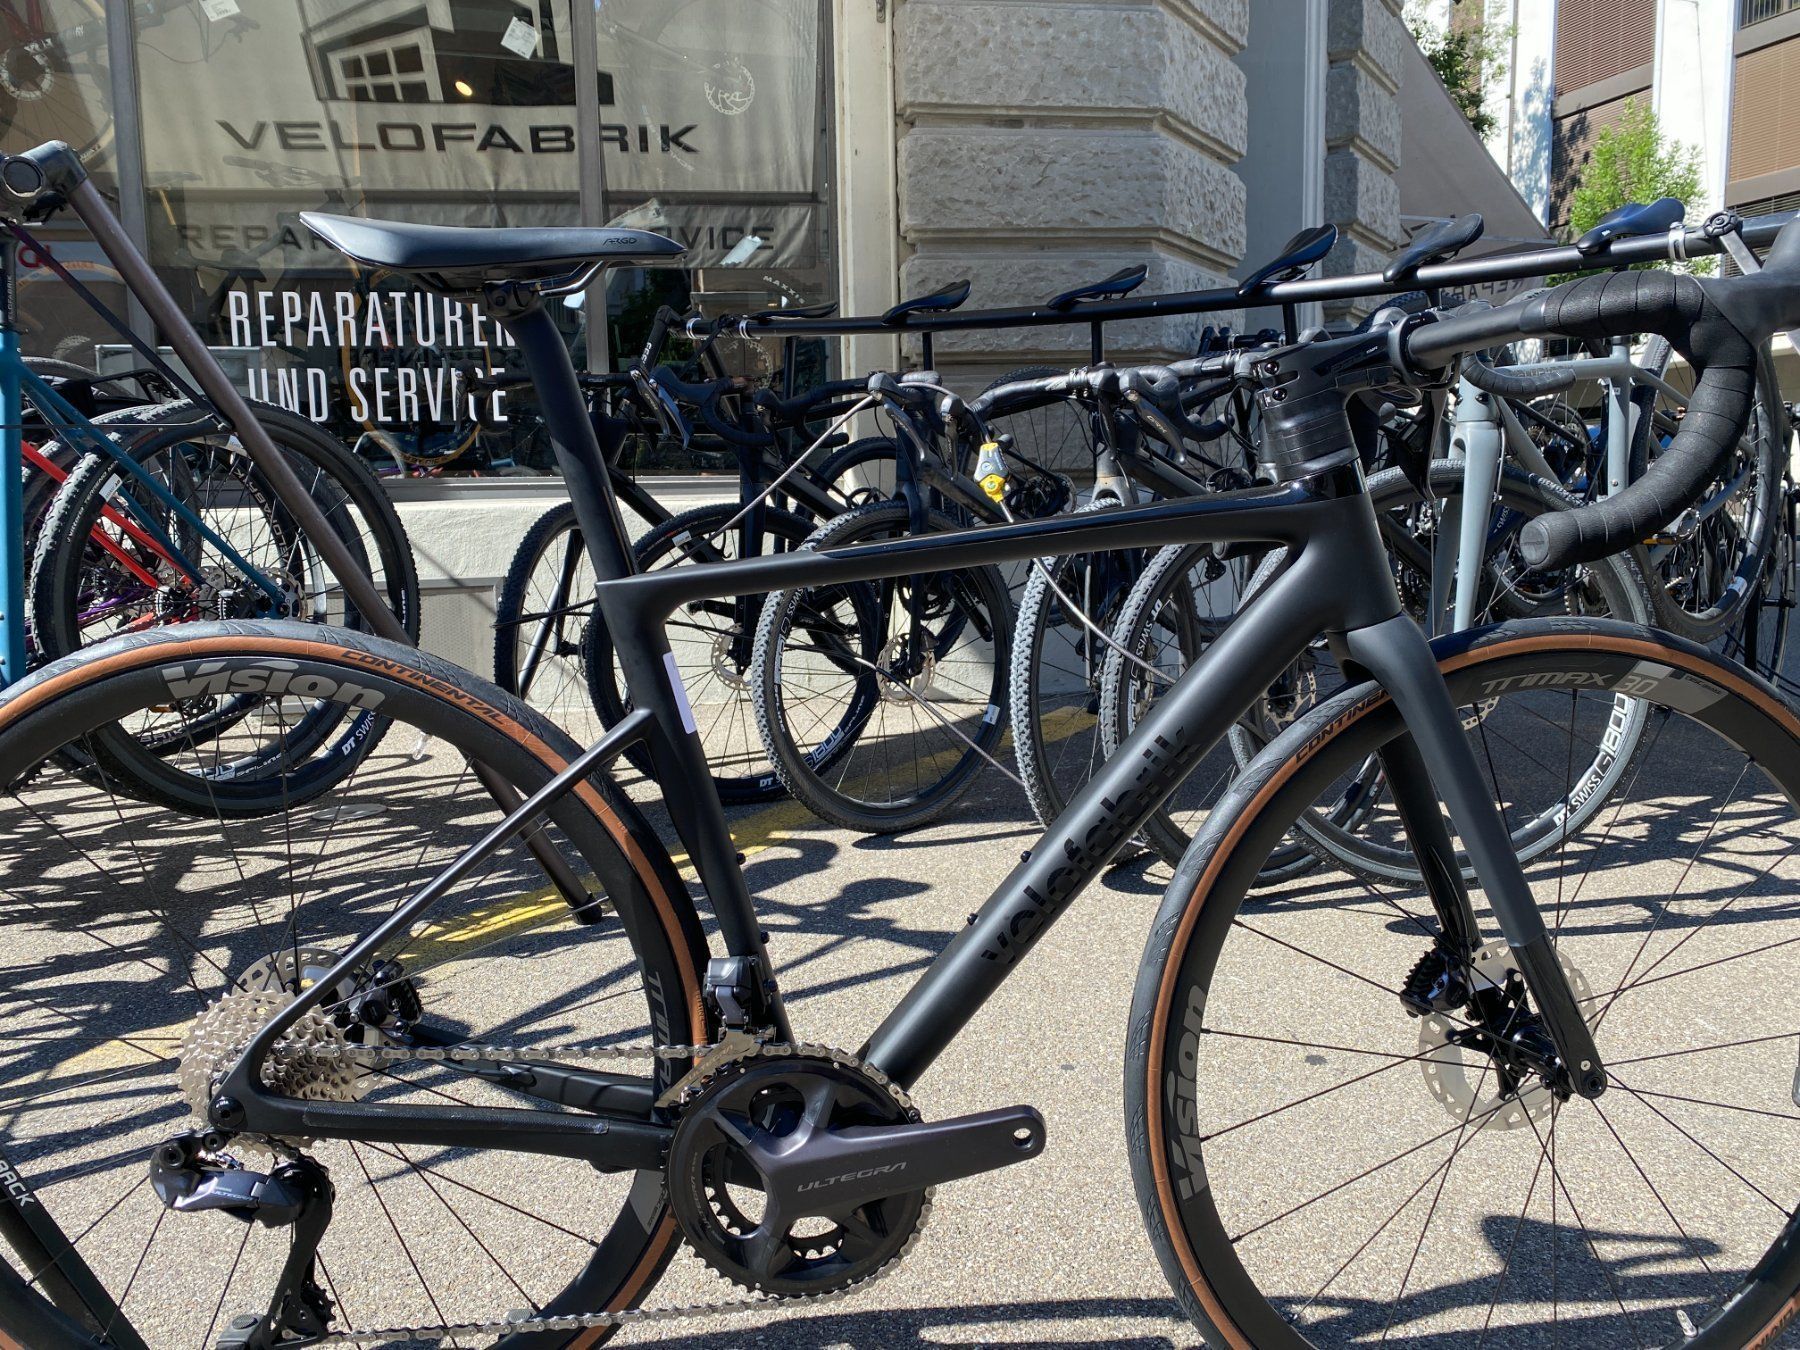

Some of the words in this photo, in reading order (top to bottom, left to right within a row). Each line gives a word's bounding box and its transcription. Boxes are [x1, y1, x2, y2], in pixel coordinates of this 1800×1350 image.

[215, 119, 700, 153] VELOFABRIK
[762, 275, 805, 304] MAXXIS
[1136, 620, 1153, 657] SWISS
[161, 660, 386, 710] Vision
[340, 650, 505, 725] CONTINENTAL
[1615, 675, 1658, 695] 30
[341, 739, 356, 756] DT
[1571, 774, 1601, 810] SWISS
[981, 726, 1197, 965] velofabrik
[1166, 984, 1208, 1200] Vision
[797, 1161, 907, 1192] ULTEGRA
